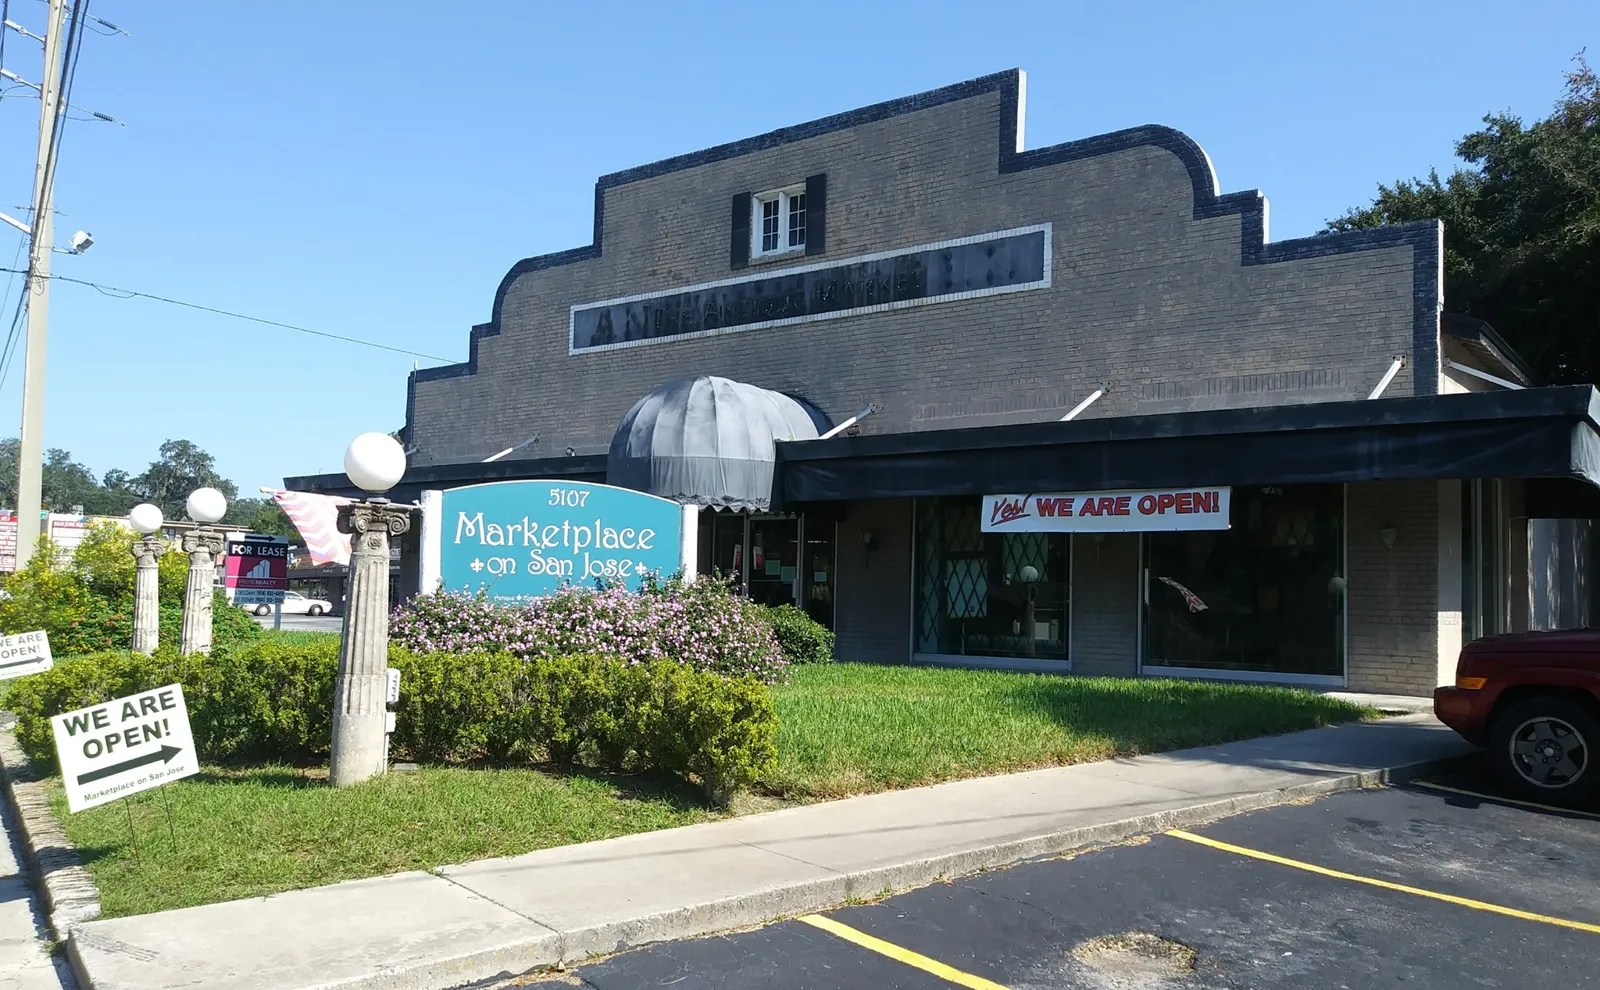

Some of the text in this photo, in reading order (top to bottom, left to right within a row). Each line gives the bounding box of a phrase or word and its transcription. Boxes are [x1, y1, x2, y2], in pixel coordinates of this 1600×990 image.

[548, 488, 590, 507] 5107
[991, 491, 1219, 525] Yes! WE ARE OPEN!
[454, 511, 655, 555] Marketplace
[232, 544, 285, 556] FOR LEASE
[486, 548, 634, 580] on San Jose
[1, 645, 40, 659] OPEN!
[18, 633, 43, 644] ARE
[63, 690, 176, 736] WE ARE
[83, 718, 171, 759] OPEN!
[84, 765, 185, 802] Marketplace on San Jose
